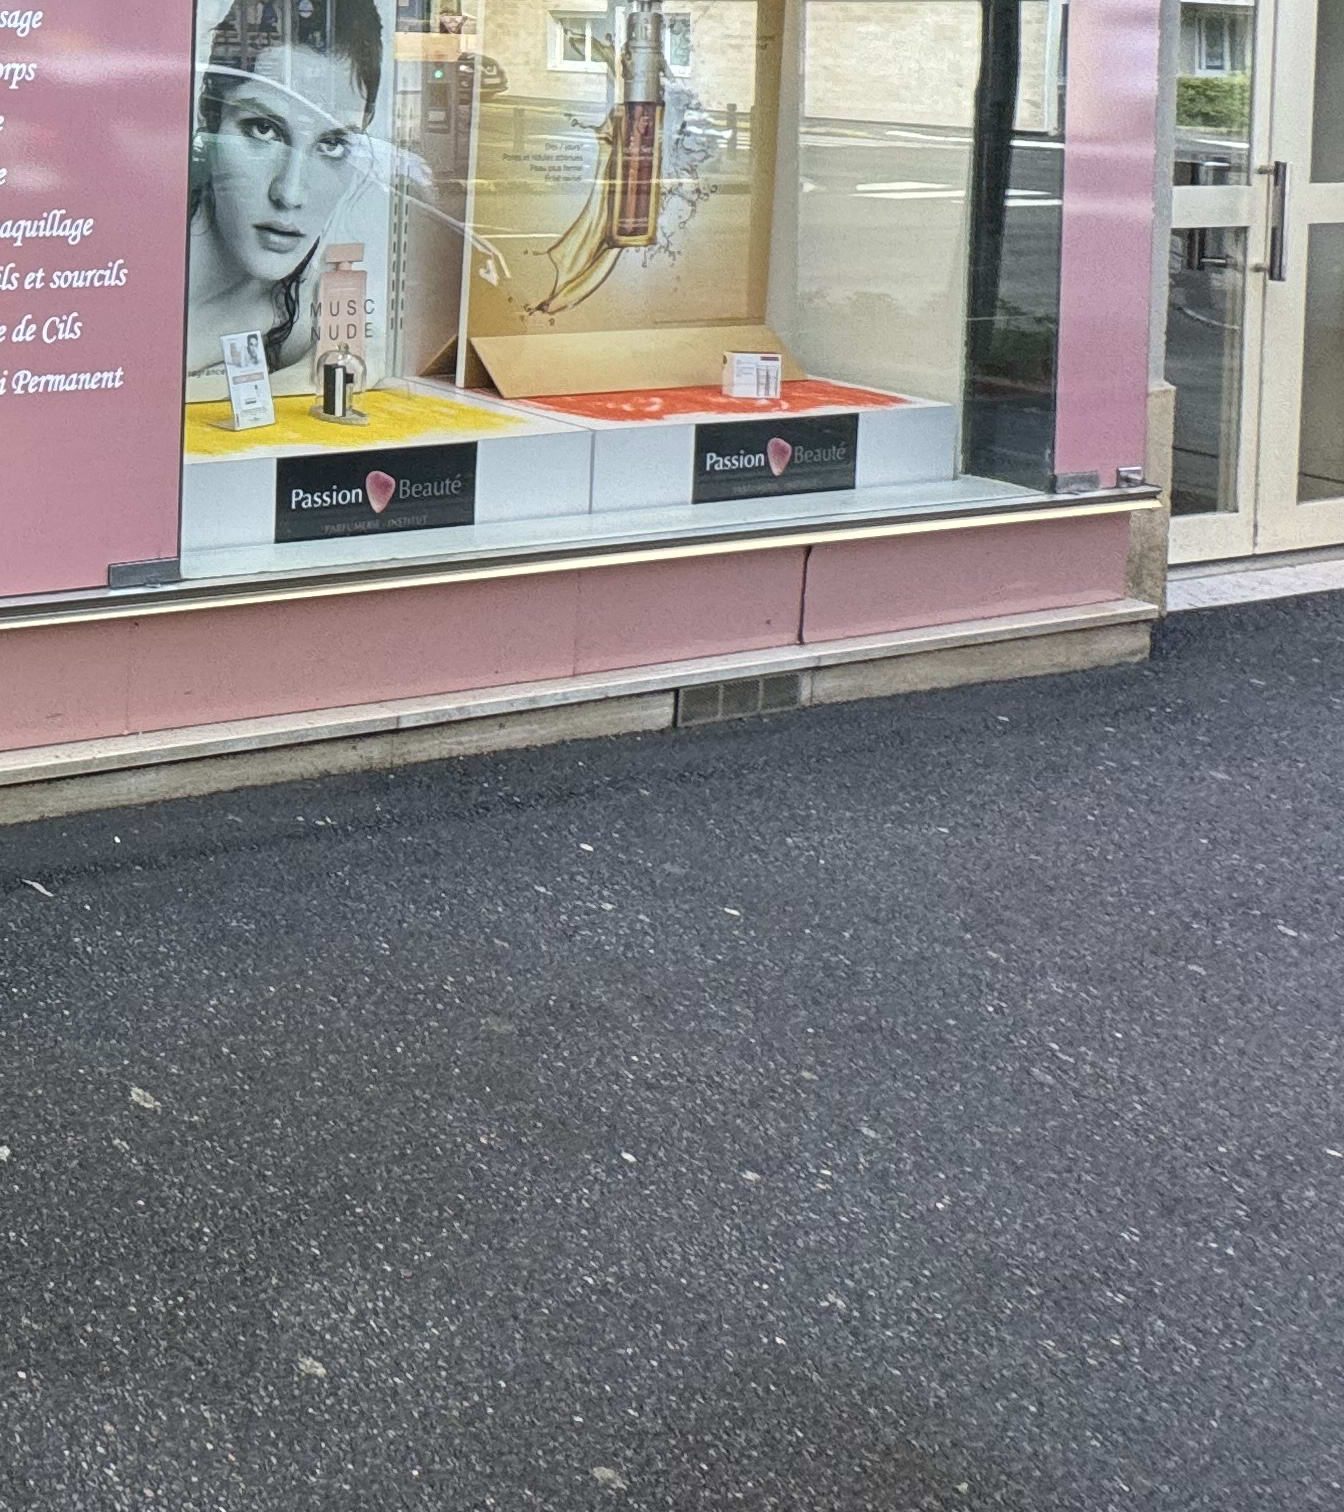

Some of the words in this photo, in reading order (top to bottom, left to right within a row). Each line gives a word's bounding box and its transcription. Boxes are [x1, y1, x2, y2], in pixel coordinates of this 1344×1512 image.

[24, 268, 45, 290] et
[49, 259, 129, 289] sourcils
[310, 299, 375, 318] MUSC
[11, 314, 36, 342] de
[42, 311, 83, 341] Cils
[310, 322, 374, 341] NUDE
[11, 366, 124, 395] Permanent
[706, 449, 765, 471] Passion
[794, 441, 846, 464] Beauté
[291, 485, 362, 510] Passion
[399, 474, 462, 499] Beauté
